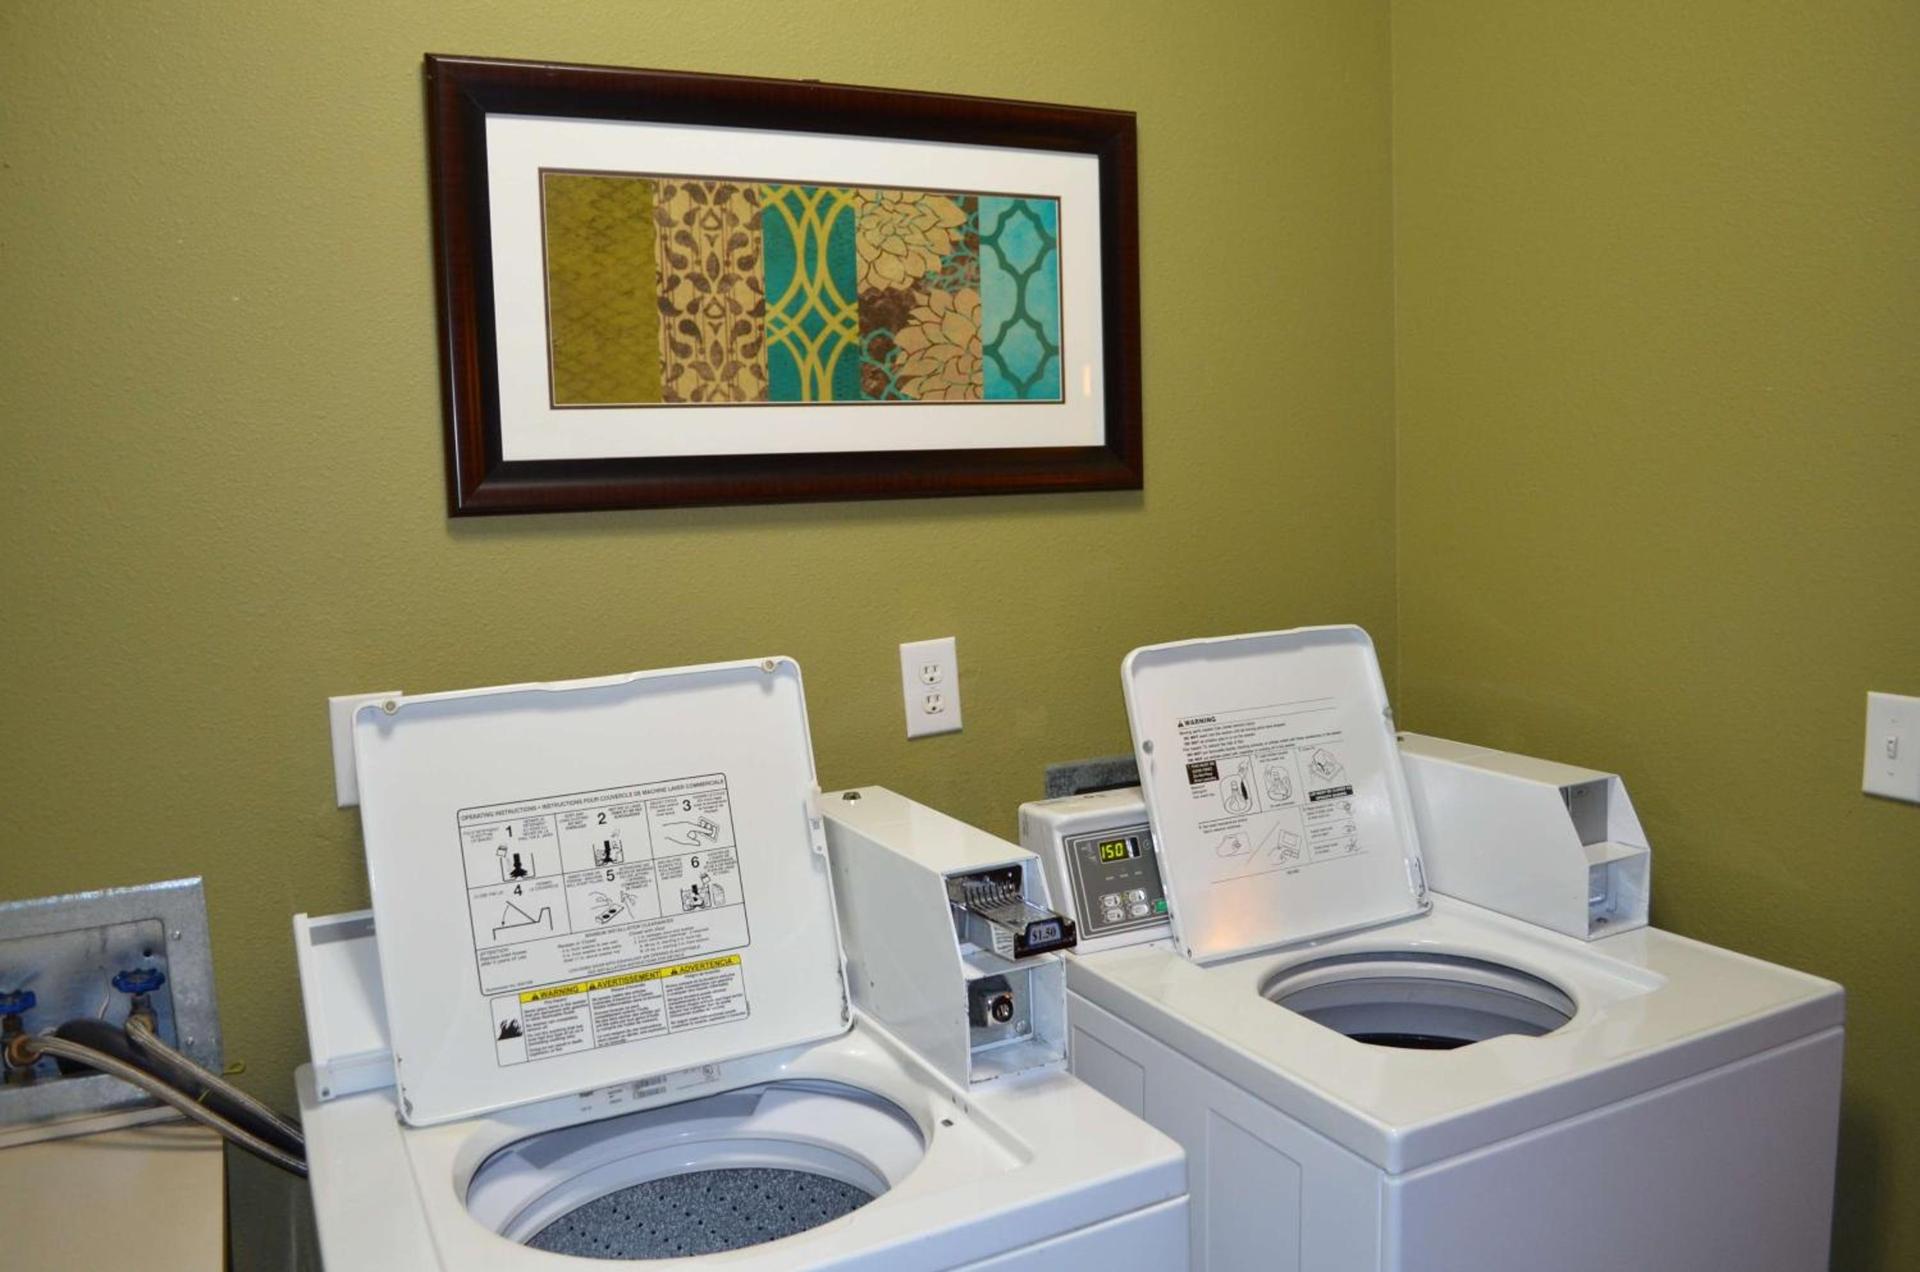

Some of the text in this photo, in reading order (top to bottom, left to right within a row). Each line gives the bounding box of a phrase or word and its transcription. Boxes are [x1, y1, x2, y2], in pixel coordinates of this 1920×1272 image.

[1184, 715, 1217, 727] WARNING
[496, 805, 537, 817] INSTRUCTIONS
[682, 799, 692, 812] 3
[597, 812, 607, 825] 2
[505, 825, 513, 838] 1
[1101, 842, 1124, 859] 150
[690, 856, 700, 868] 6
[606, 870, 615, 882] 5
[513, 884, 523, 897] 4
[1031, 926, 1058, 941] $1.50
[679, 957, 733, 975] ADVERTENCIA
[596, 970, 661, 990] AVERTISSEMENT
[540, 983, 579, 1000] WARNING
